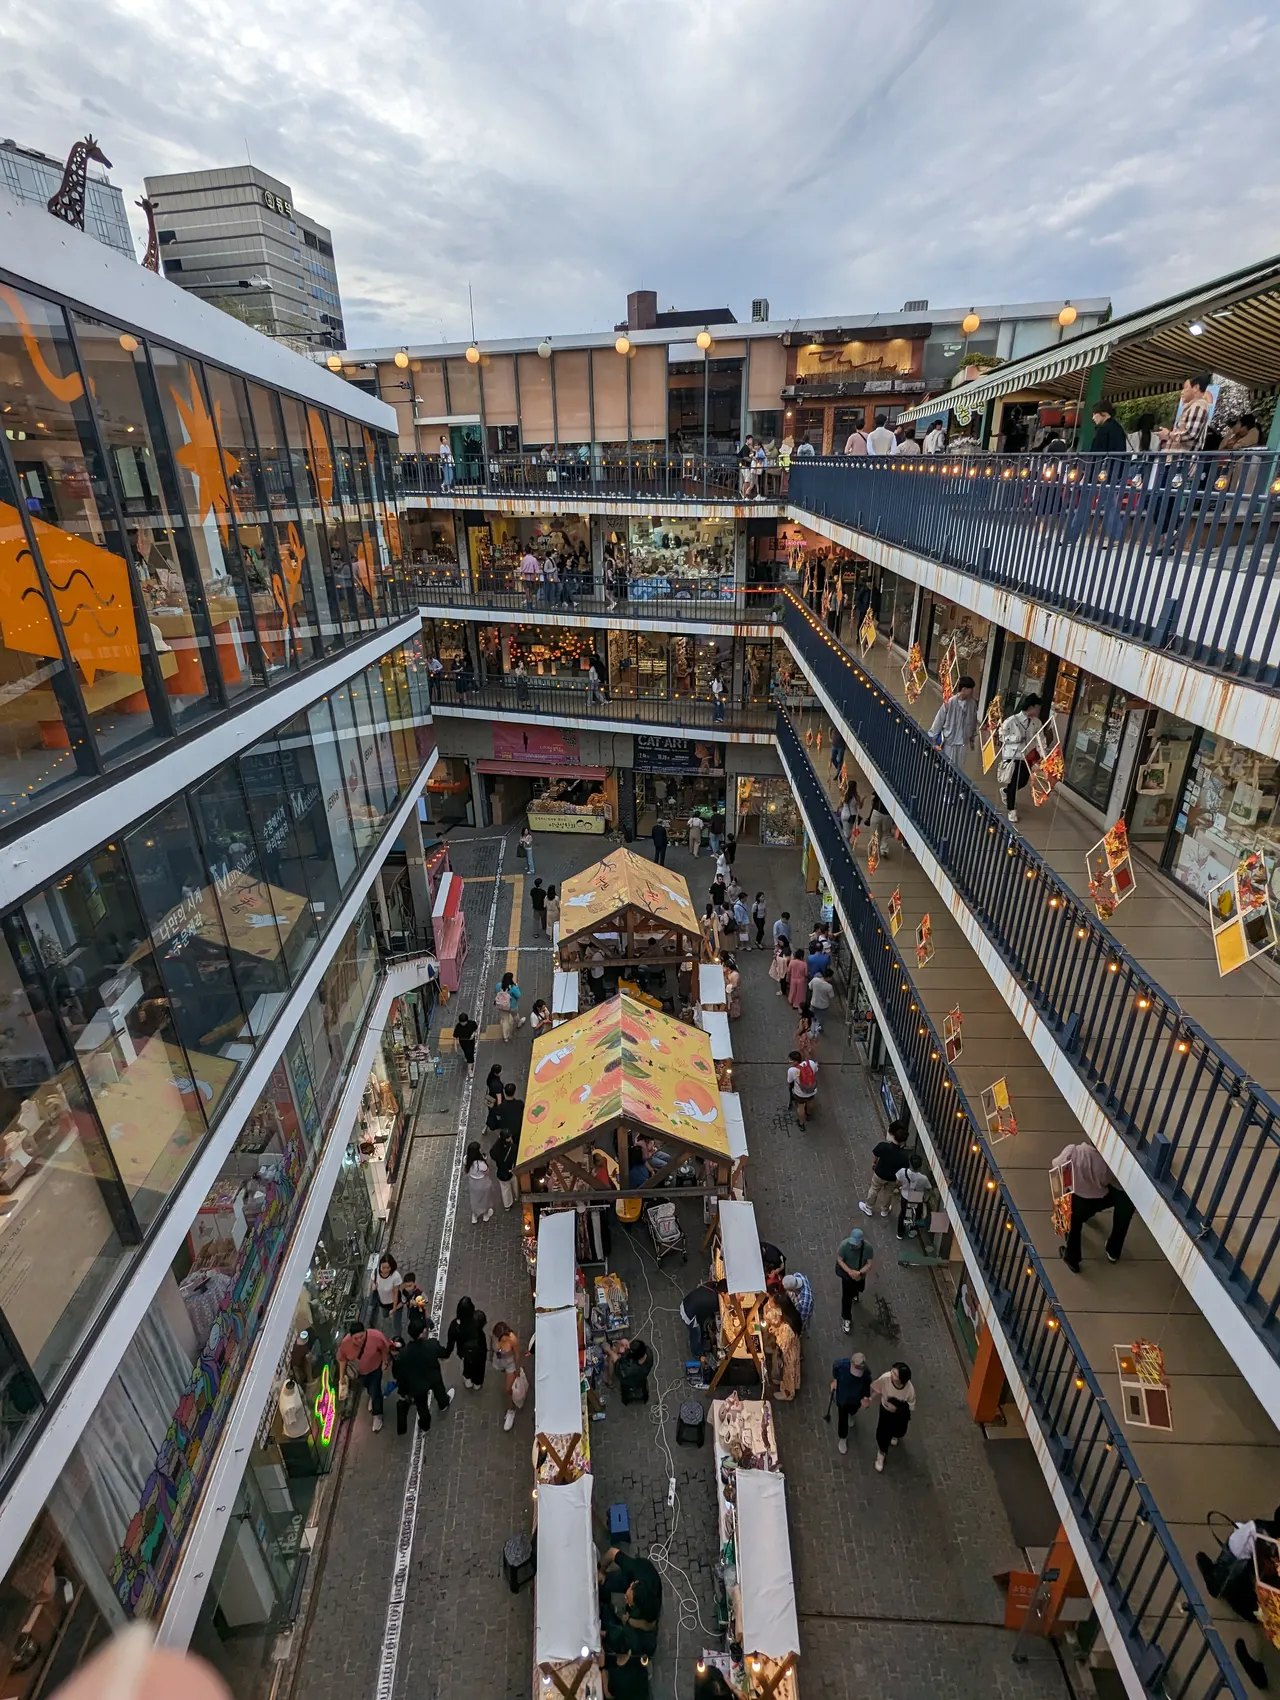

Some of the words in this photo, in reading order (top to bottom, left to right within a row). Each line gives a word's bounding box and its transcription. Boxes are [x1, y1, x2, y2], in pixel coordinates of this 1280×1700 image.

[209, 848, 257, 897] Mari&Mari
[159, 904, 187, 940] 나만의
[187, 886, 204, 912] 시계
[172, 912, 204, 956] 주문제작
